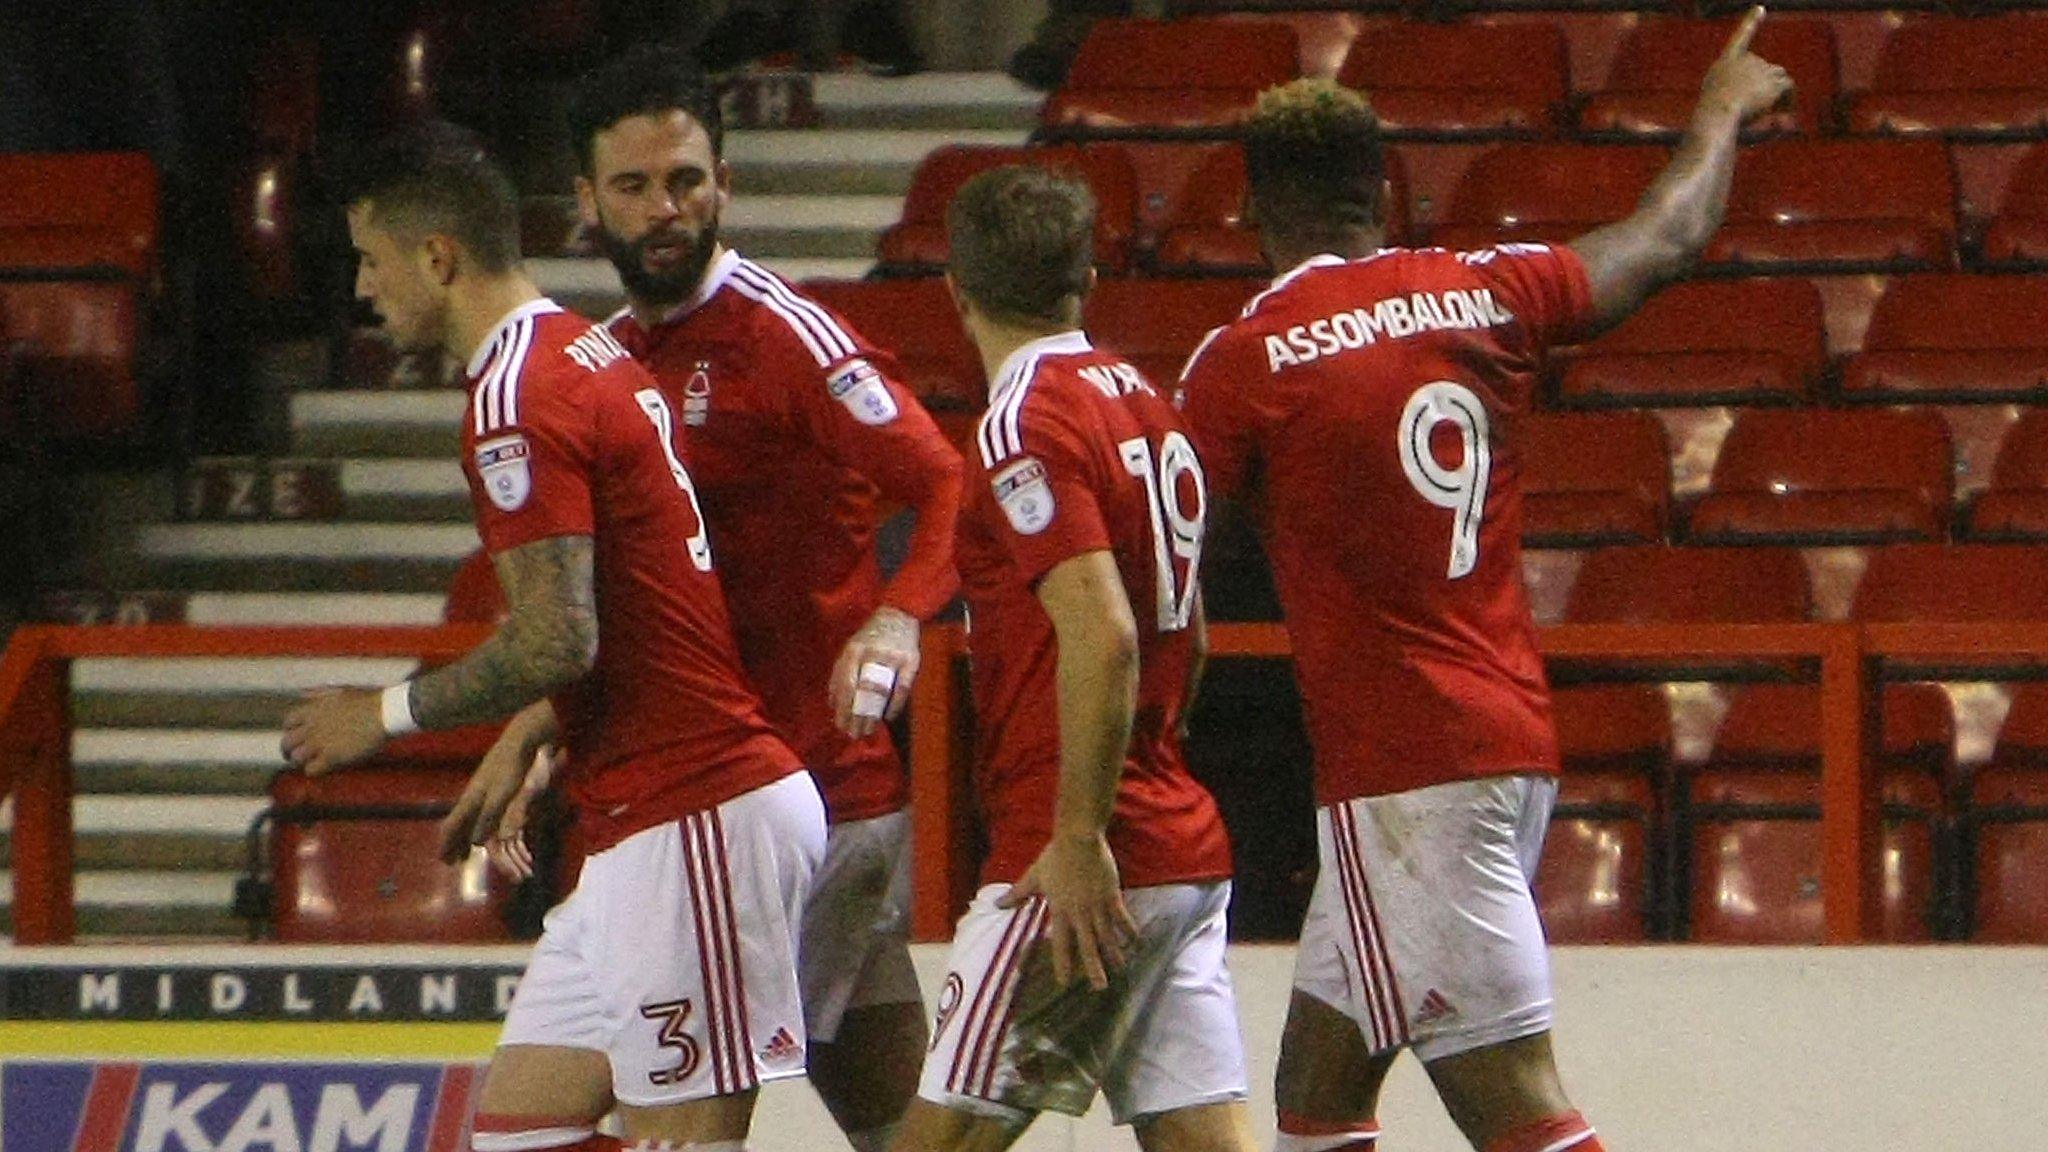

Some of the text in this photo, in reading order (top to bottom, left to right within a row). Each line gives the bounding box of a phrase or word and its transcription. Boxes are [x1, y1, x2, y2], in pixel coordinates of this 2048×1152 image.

[1118, 431, 1206, 632] 19
[1398, 380, 1492, 579] 9
[641, 998, 700, 1084] 3
[134, 1081, 421, 1152] KAM
